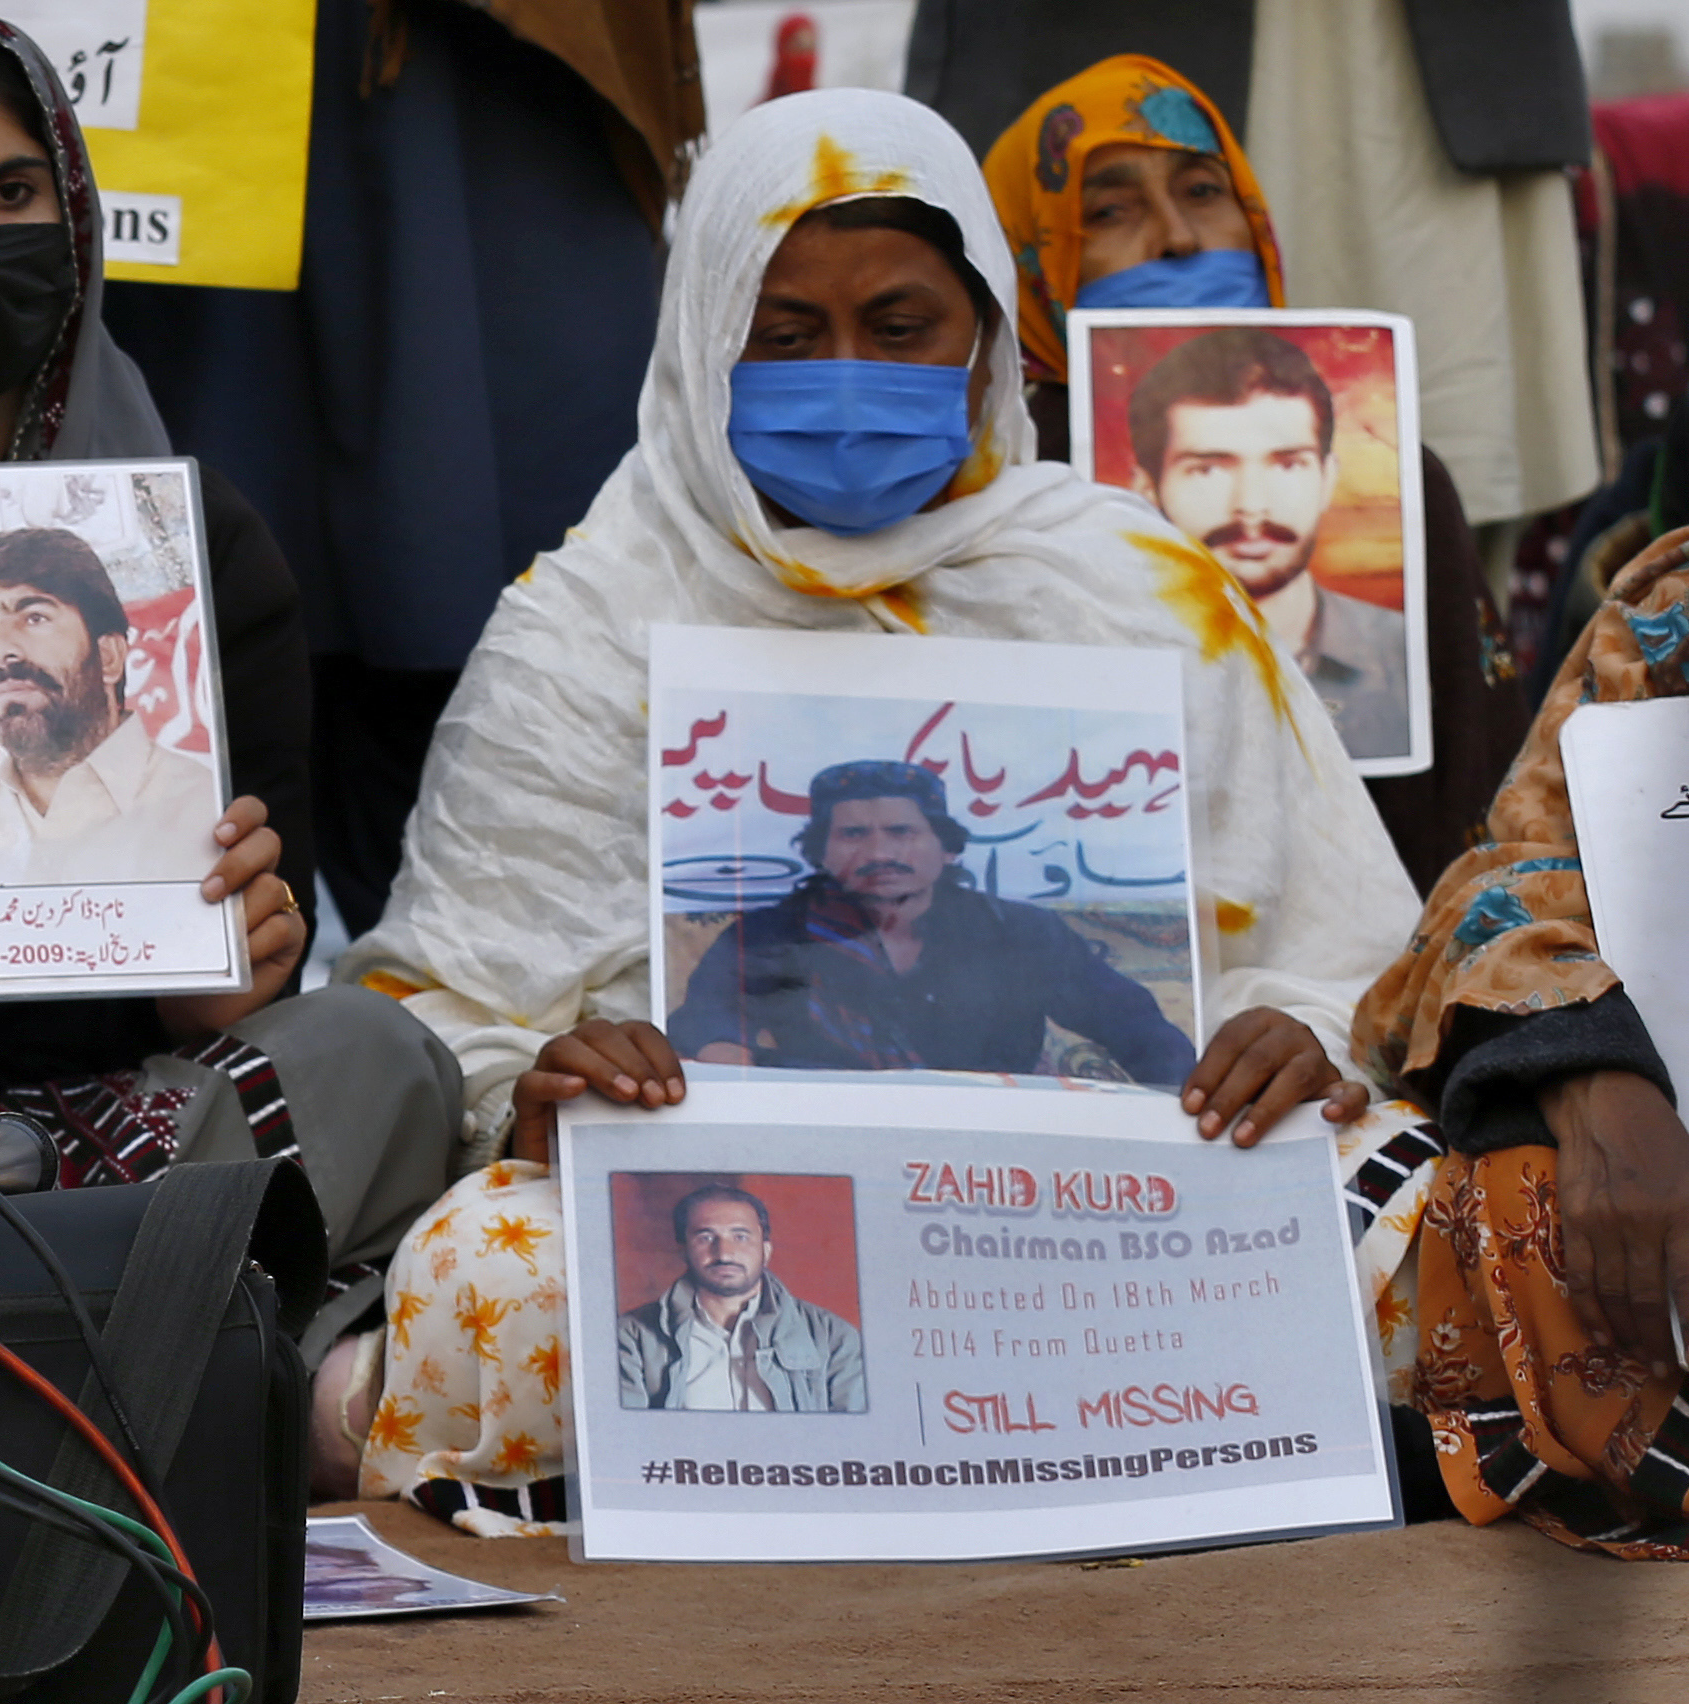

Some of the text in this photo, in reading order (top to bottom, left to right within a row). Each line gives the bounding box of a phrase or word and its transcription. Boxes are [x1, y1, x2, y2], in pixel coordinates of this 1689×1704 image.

[23, 902, 54, 929] دین
[904, 1162, 1178, 1214] ZAHID KURD
[920, 1217, 1301, 1261] Chairman BSO Azad
[908, 1270, 1281, 1312] Abducted On 18th March
[911, 1327, 1185, 1357] 2014 From Quetta
[943, 1383, 1260, 1434] STILL MISSING
[640, 1432, 1318, 1487] #ReleaseBalochMissingPersons
